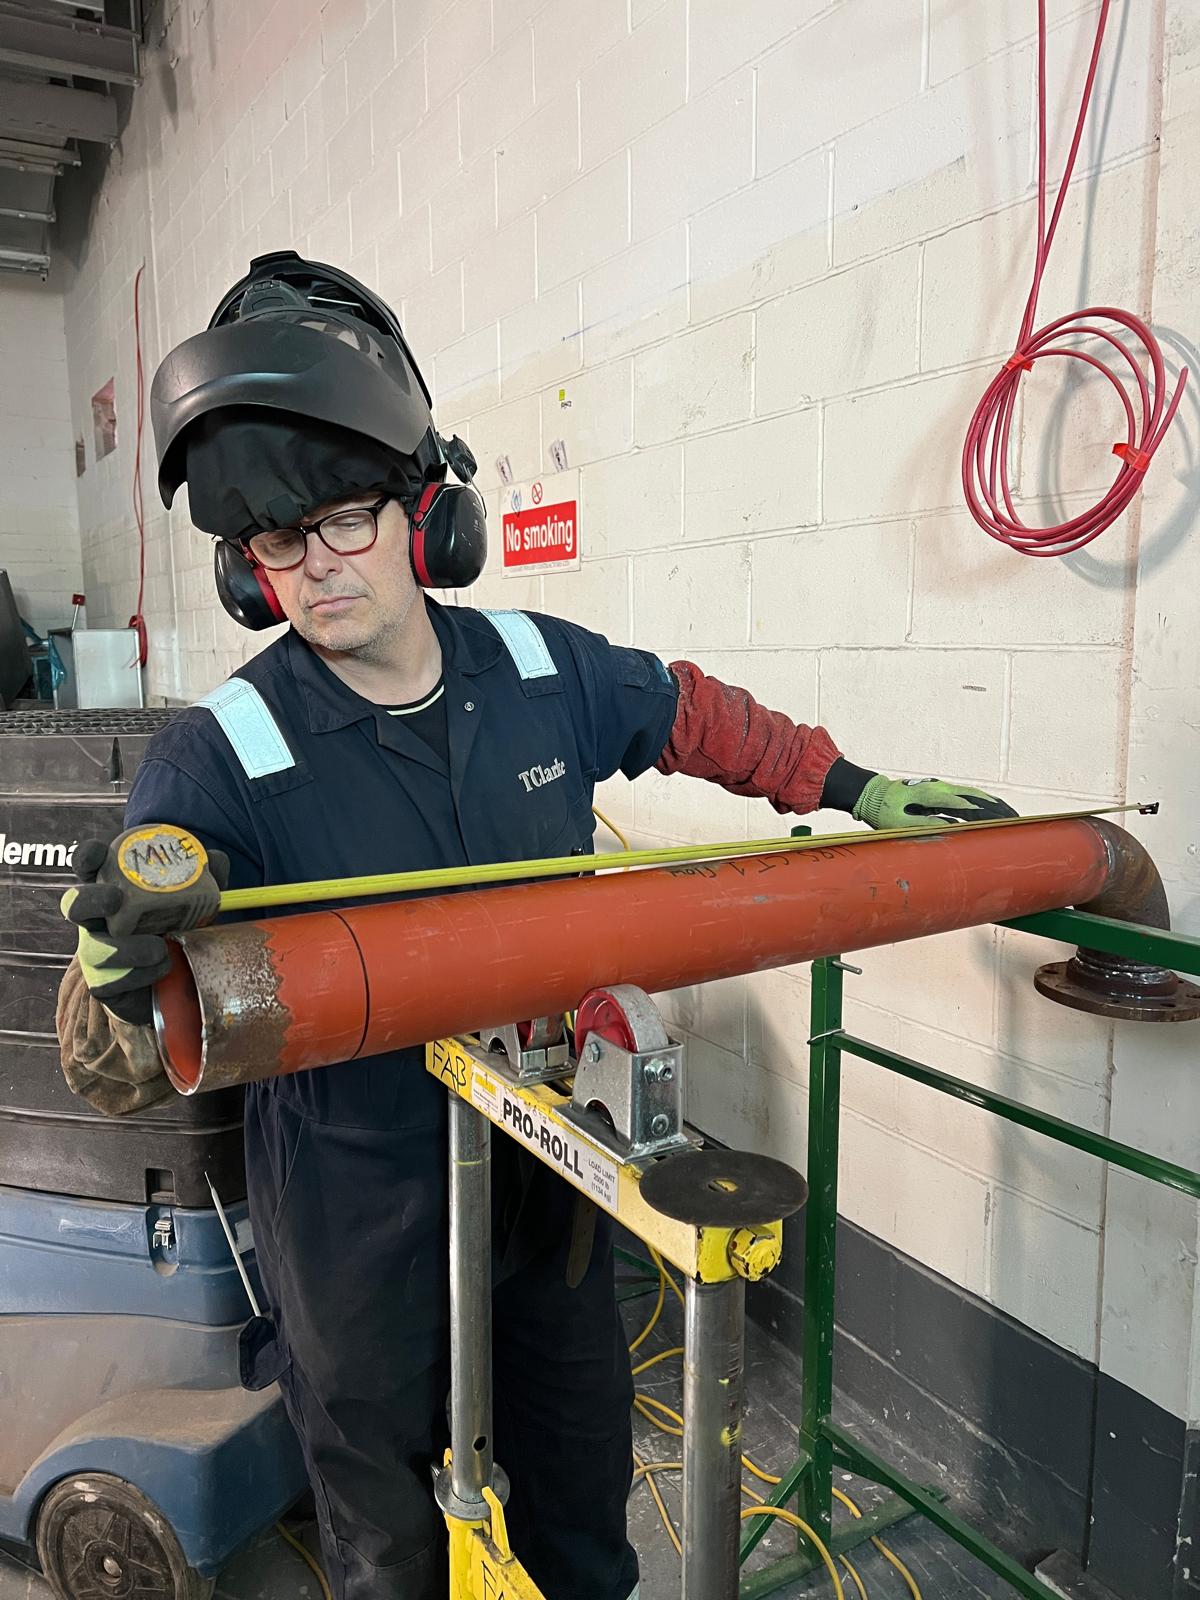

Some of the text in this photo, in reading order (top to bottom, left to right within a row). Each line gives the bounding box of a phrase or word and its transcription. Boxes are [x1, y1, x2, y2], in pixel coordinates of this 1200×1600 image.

[505, 514, 573, 553] No smoking
[517, 757, 566, 793] TClarke
[129, 837, 199, 875] MIKE
[432, 1040, 467, 1094] FAB
[502, 1097, 584, 1180] PRO-ROLL
[588, 1159, 615, 1183] LOAD LIMIT
